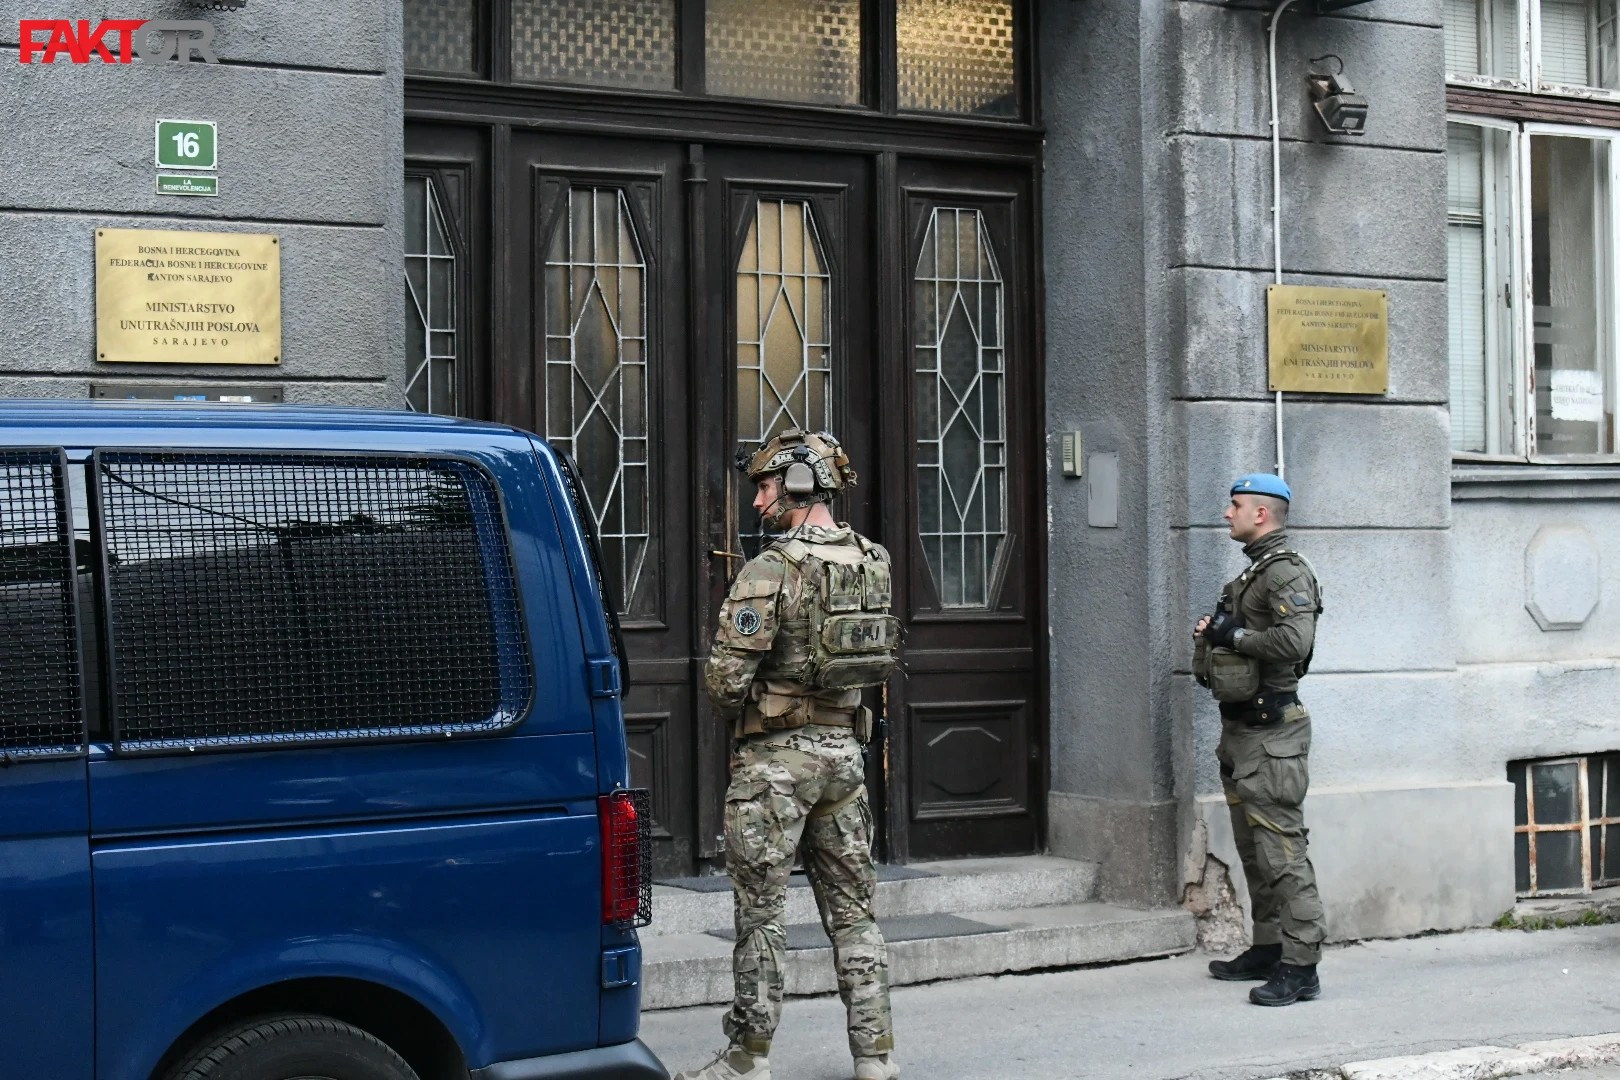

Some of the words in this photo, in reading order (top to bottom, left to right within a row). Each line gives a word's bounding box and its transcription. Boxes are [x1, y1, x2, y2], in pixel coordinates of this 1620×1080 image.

[172, 132, 200, 158] 16
[163, 184, 212, 192] BENEVOLENCIJA
[138, 245, 168, 255] BOSNA
[175, 247, 241, 257] HERCEGOVINA
[110, 258, 165, 269] FEDERACIJA
[167, 260, 197, 269] BOSNE
[204, 262, 268, 271] HERCEGOVINE
[147, 273, 185, 282] KANTON
[187, 274, 233, 284] SARAJEVO
[146, 302, 235, 314] MINISTARSTVO
[120, 318, 204, 332] UNUTRAŠNJIH
[206, 321, 260, 333] POSLOVA
[1300, 344, 1359, 354] MINISTARSTVO
[1340, 360, 1374, 369] POSLOVA
